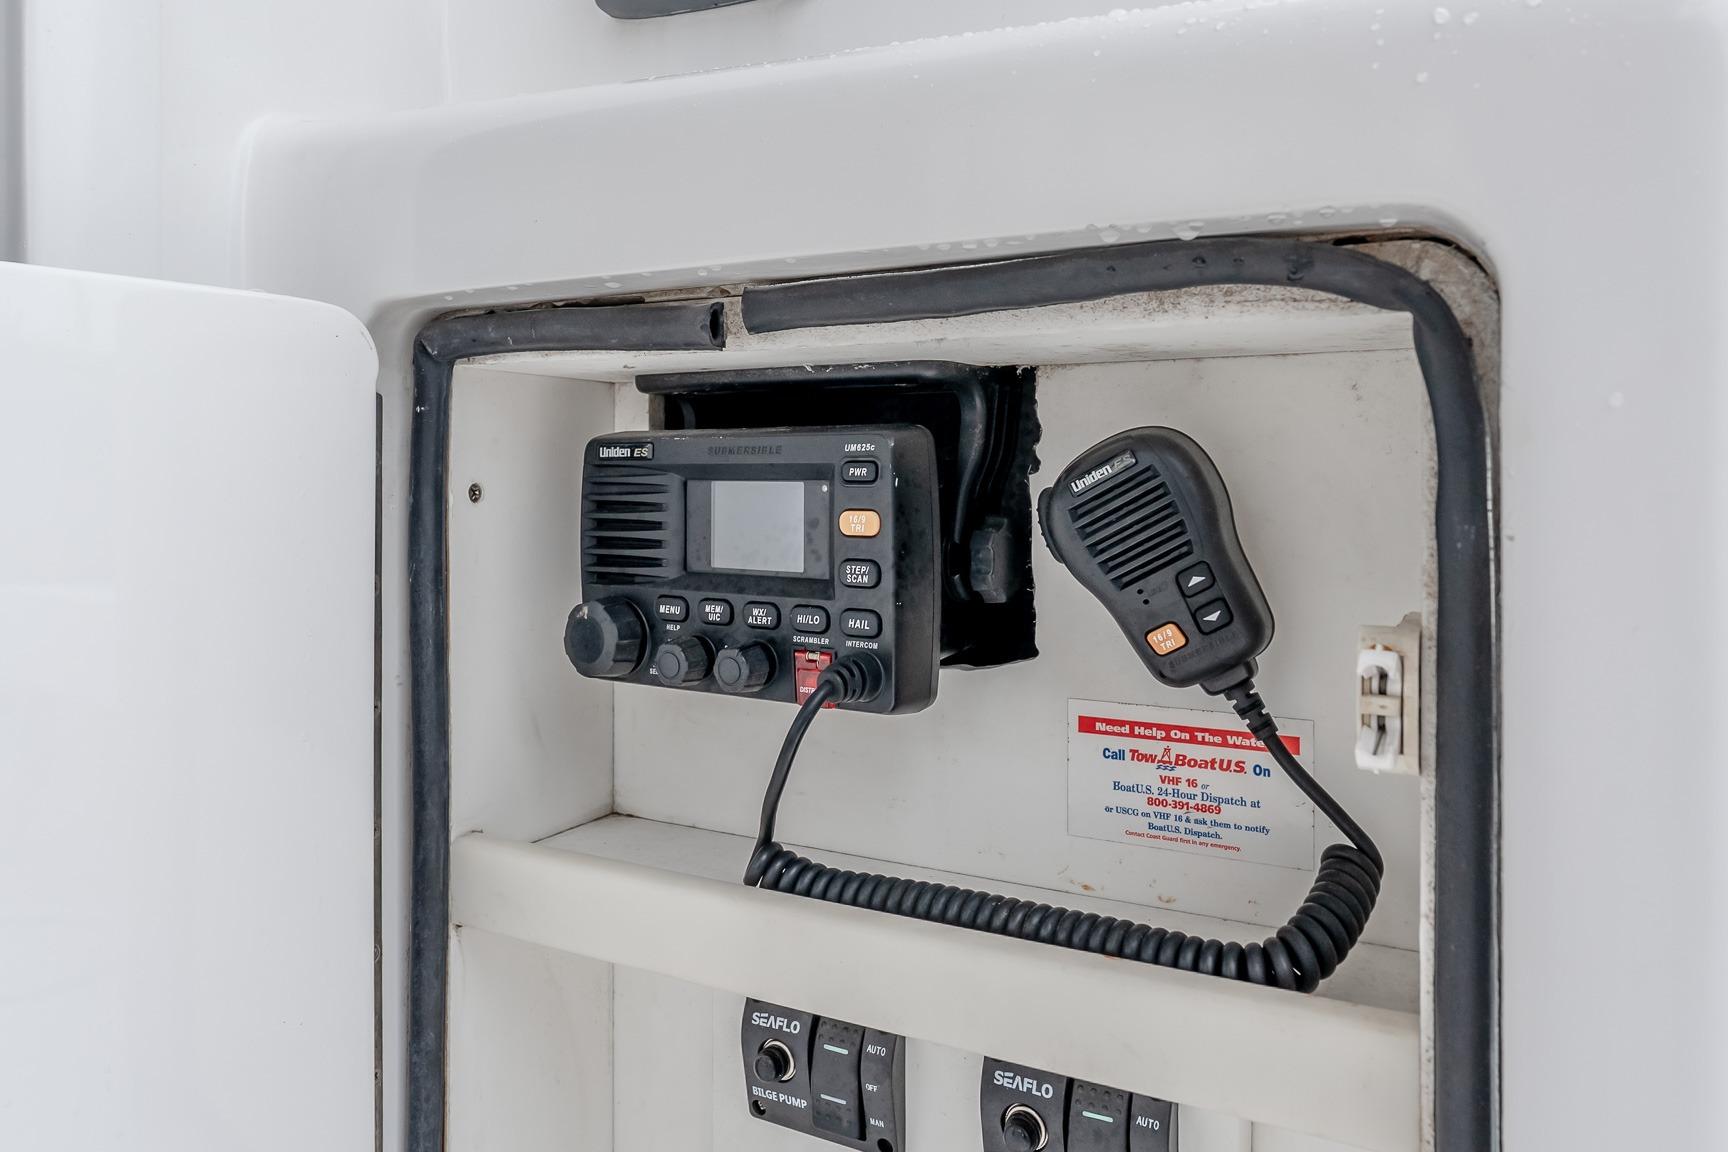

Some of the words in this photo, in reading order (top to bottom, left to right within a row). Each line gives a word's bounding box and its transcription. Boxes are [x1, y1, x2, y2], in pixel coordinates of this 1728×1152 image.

[600, 447, 631, 458] Uniden
[633, 448, 649, 458] ES
[844, 443, 876, 452] UM625c
[848, 467, 868, 477] PWR
[1070, 464, 1113, 494] Uniden
[848, 515, 866, 524] 16/9
[850, 524, 865, 533] TRI
[845, 565, 870, 575] STEP/
[846, 574, 869, 583] SCAN
[659, 604, 681, 615] MENU
[704, 604, 724, 613] MEM/
[752, 608, 767, 616] WX/
[708, 613, 721, 622] UIC
[747, 616, 772, 626] ALERT
[797, 614, 820, 625] HI/LO
[848, 619, 870, 630] HAIL
[792, 635, 830, 645] SCRAMBLER
[1152, 628, 1173, 644] 16/9
[845, 640, 879, 650] INTERCOM
[1159, 638, 1176, 652] TRI
[1095, 722, 1130, 734] Need
[1134, 726, 1166, 739] Help
[1170, 729, 1190, 740] On
[1194, 732, 1222, 744] The
[1226, 735, 1265, 748] Wate
[1102, 747, 1126, 760] Call
[1252, 764, 1271, 778] On
[1159, 775, 1182, 786] VHF
[1185, 778, 1198, 788] 16
[1112, 781, 1155, 796] BoatU.S.
[1157, 786, 1198, 801] 24-Hour
[1200, 791, 1247, 807] Dispatch
[1250, 799, 1261, 809] at
[1146, 796, 1222, 815] 800-391-4869
[1115, 806, 1139, 817] USCG
[1141, 810, 1151, 818] on
[1153, 811, 1172, 821] VHF
[1174, 814, 1183, 823] 16
[1184, 816, 1192, 824] &
[1193, 817, 1208, 826] ask
[1210, 819, 1231, 829] them
[1234, 823, 1243, 831] to
[1245, 824, 1271, 836] notify
[1125, 829, 1145, 838] Contact
[1146, 832, 1161, 840] Coast
[1162, 835, 1179, 843] Guard
[1147, 821, 1182, 834] BoatU.S.
[1184, 827, 1223, 840] Dispatch.
[751, 1011, 801, 1034] SEAFLO
[866, 1044, 887, 1056] AUTO
[865, 1083, 878, 1093] OFF
[993, 1070, 1054, 1099] SEAFLO
[752, 1085, 778, 1102] BILGE
[779, 1093, 808, 1109] PUMP
[869, 1117, 885, 1128] MAN
[1135, 1115, 1160, 1131] AUTO
